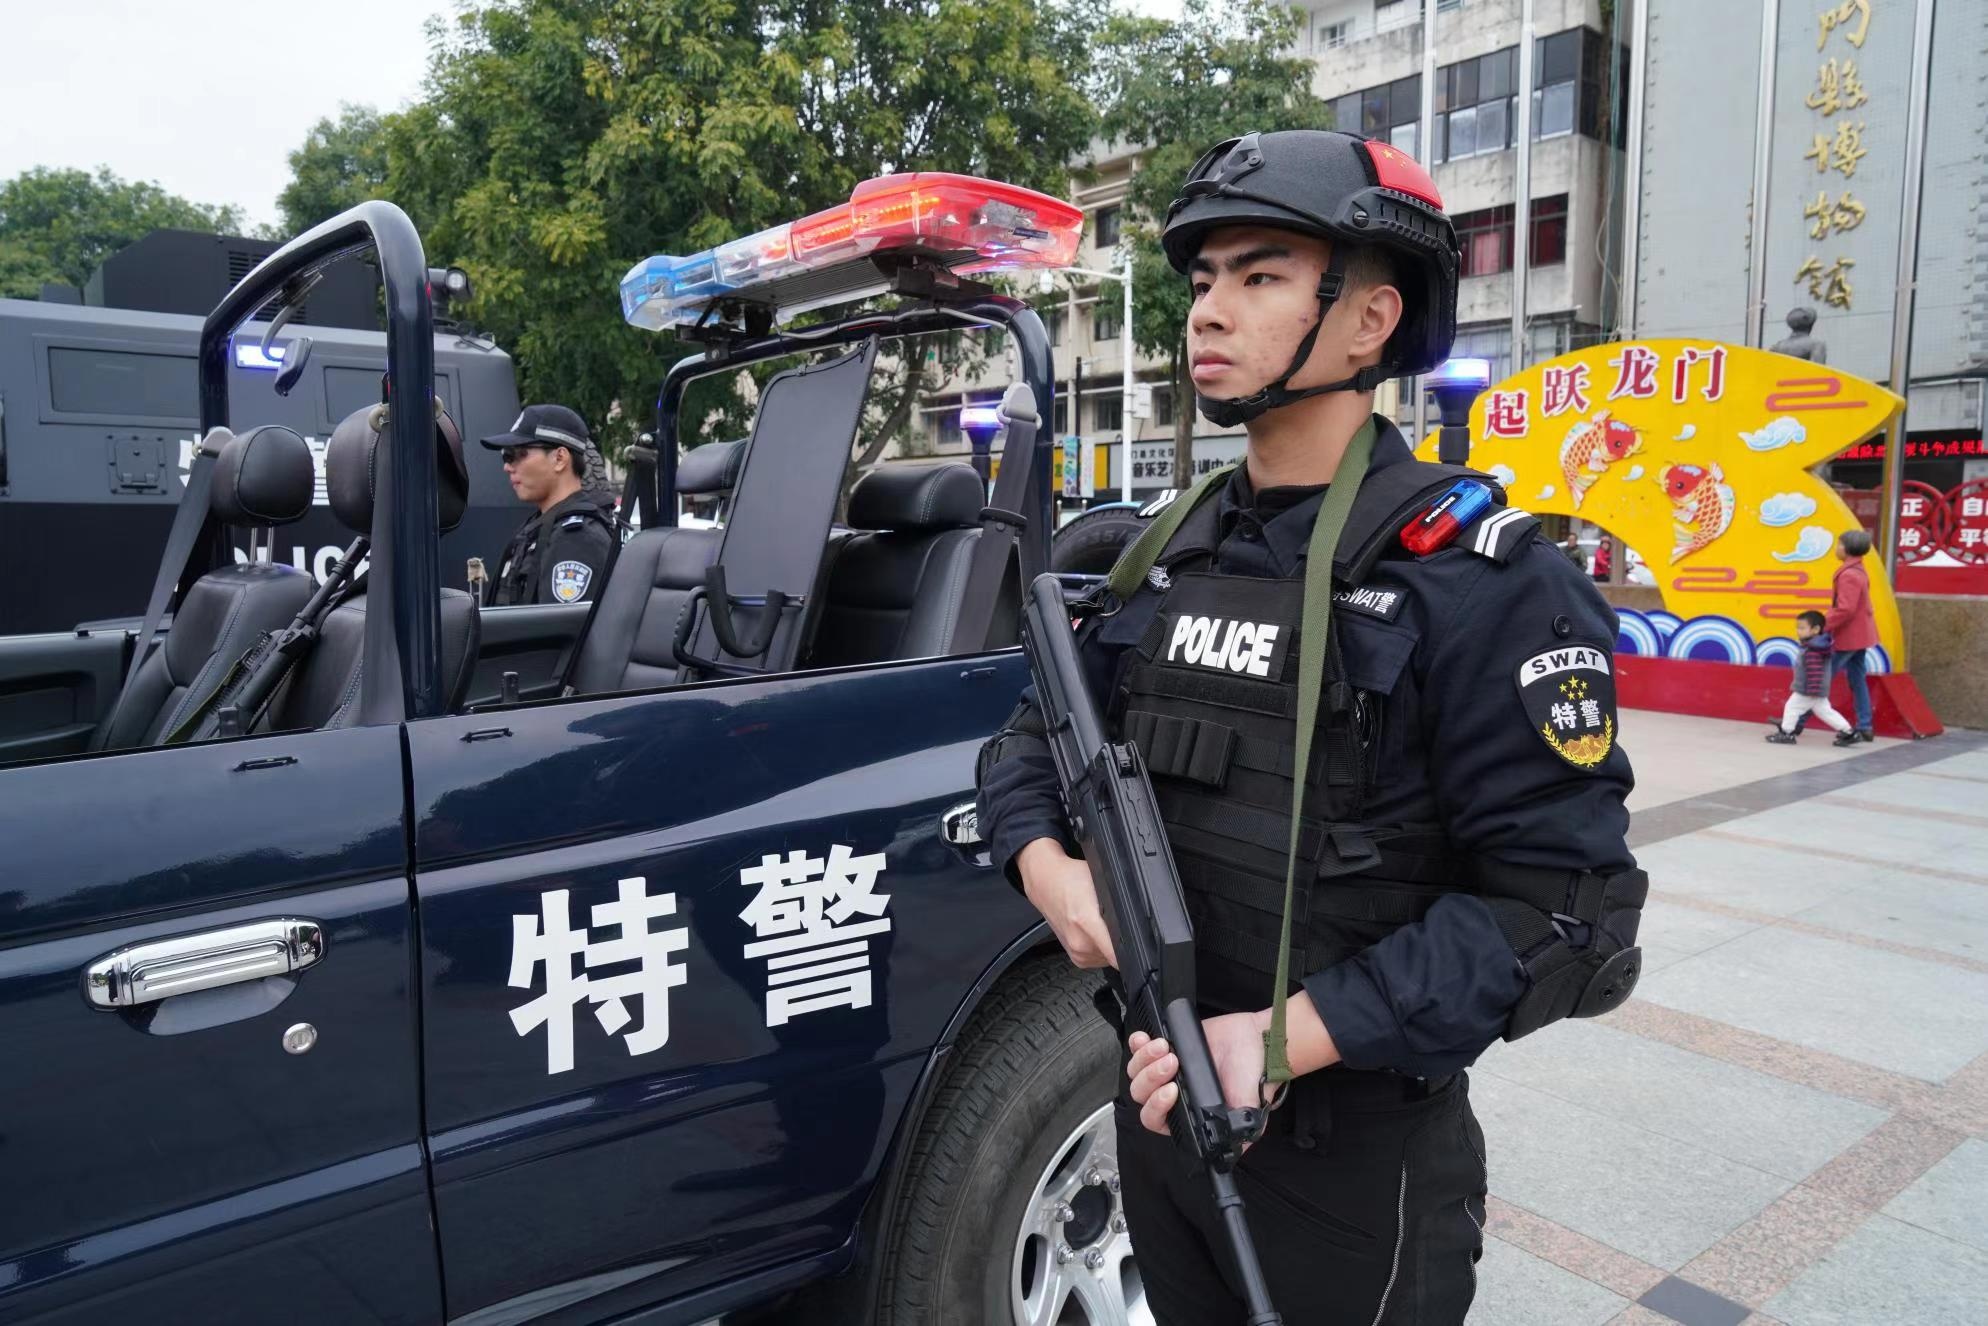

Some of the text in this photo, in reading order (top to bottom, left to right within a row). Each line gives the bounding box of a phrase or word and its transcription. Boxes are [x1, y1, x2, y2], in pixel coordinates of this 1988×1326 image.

[1484, 346, 1726, 439] 起跃龙门
[1962, 497, 1988, 517] 自
[1167, 615, 1280, 677] POLICE
[1532, 650, 1599, 675] SWAT
[1551, 698, 1601, 730] 特警
[508, 844, 892, 1075] 特警
